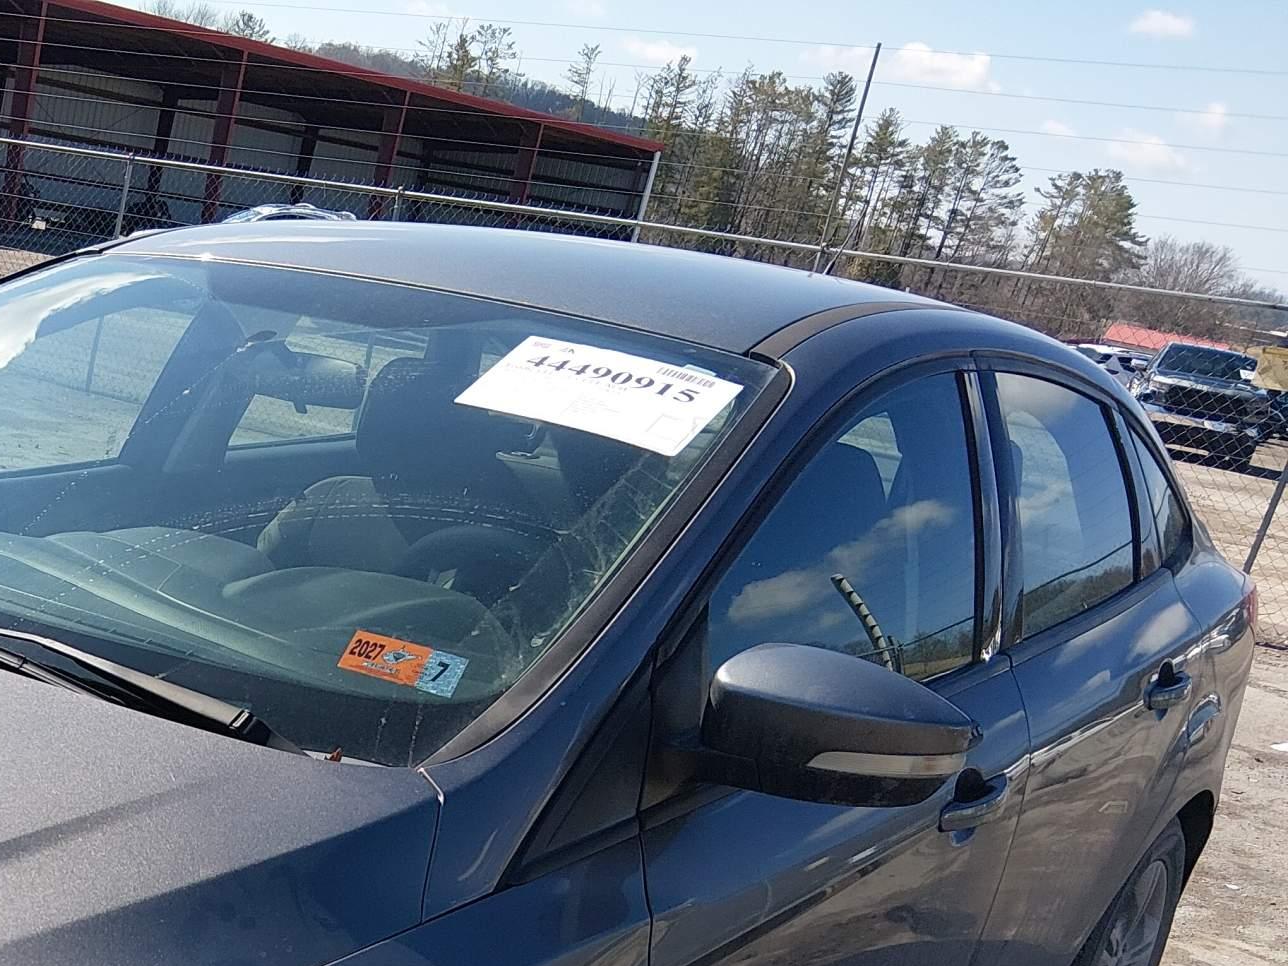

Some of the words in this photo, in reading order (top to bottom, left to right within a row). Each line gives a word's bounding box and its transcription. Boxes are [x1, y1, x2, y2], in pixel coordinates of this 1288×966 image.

[526, 355, 701, 403] 44490915
[348, 638, 386, 661] 2027
[429, 661, 451, 682] 7
